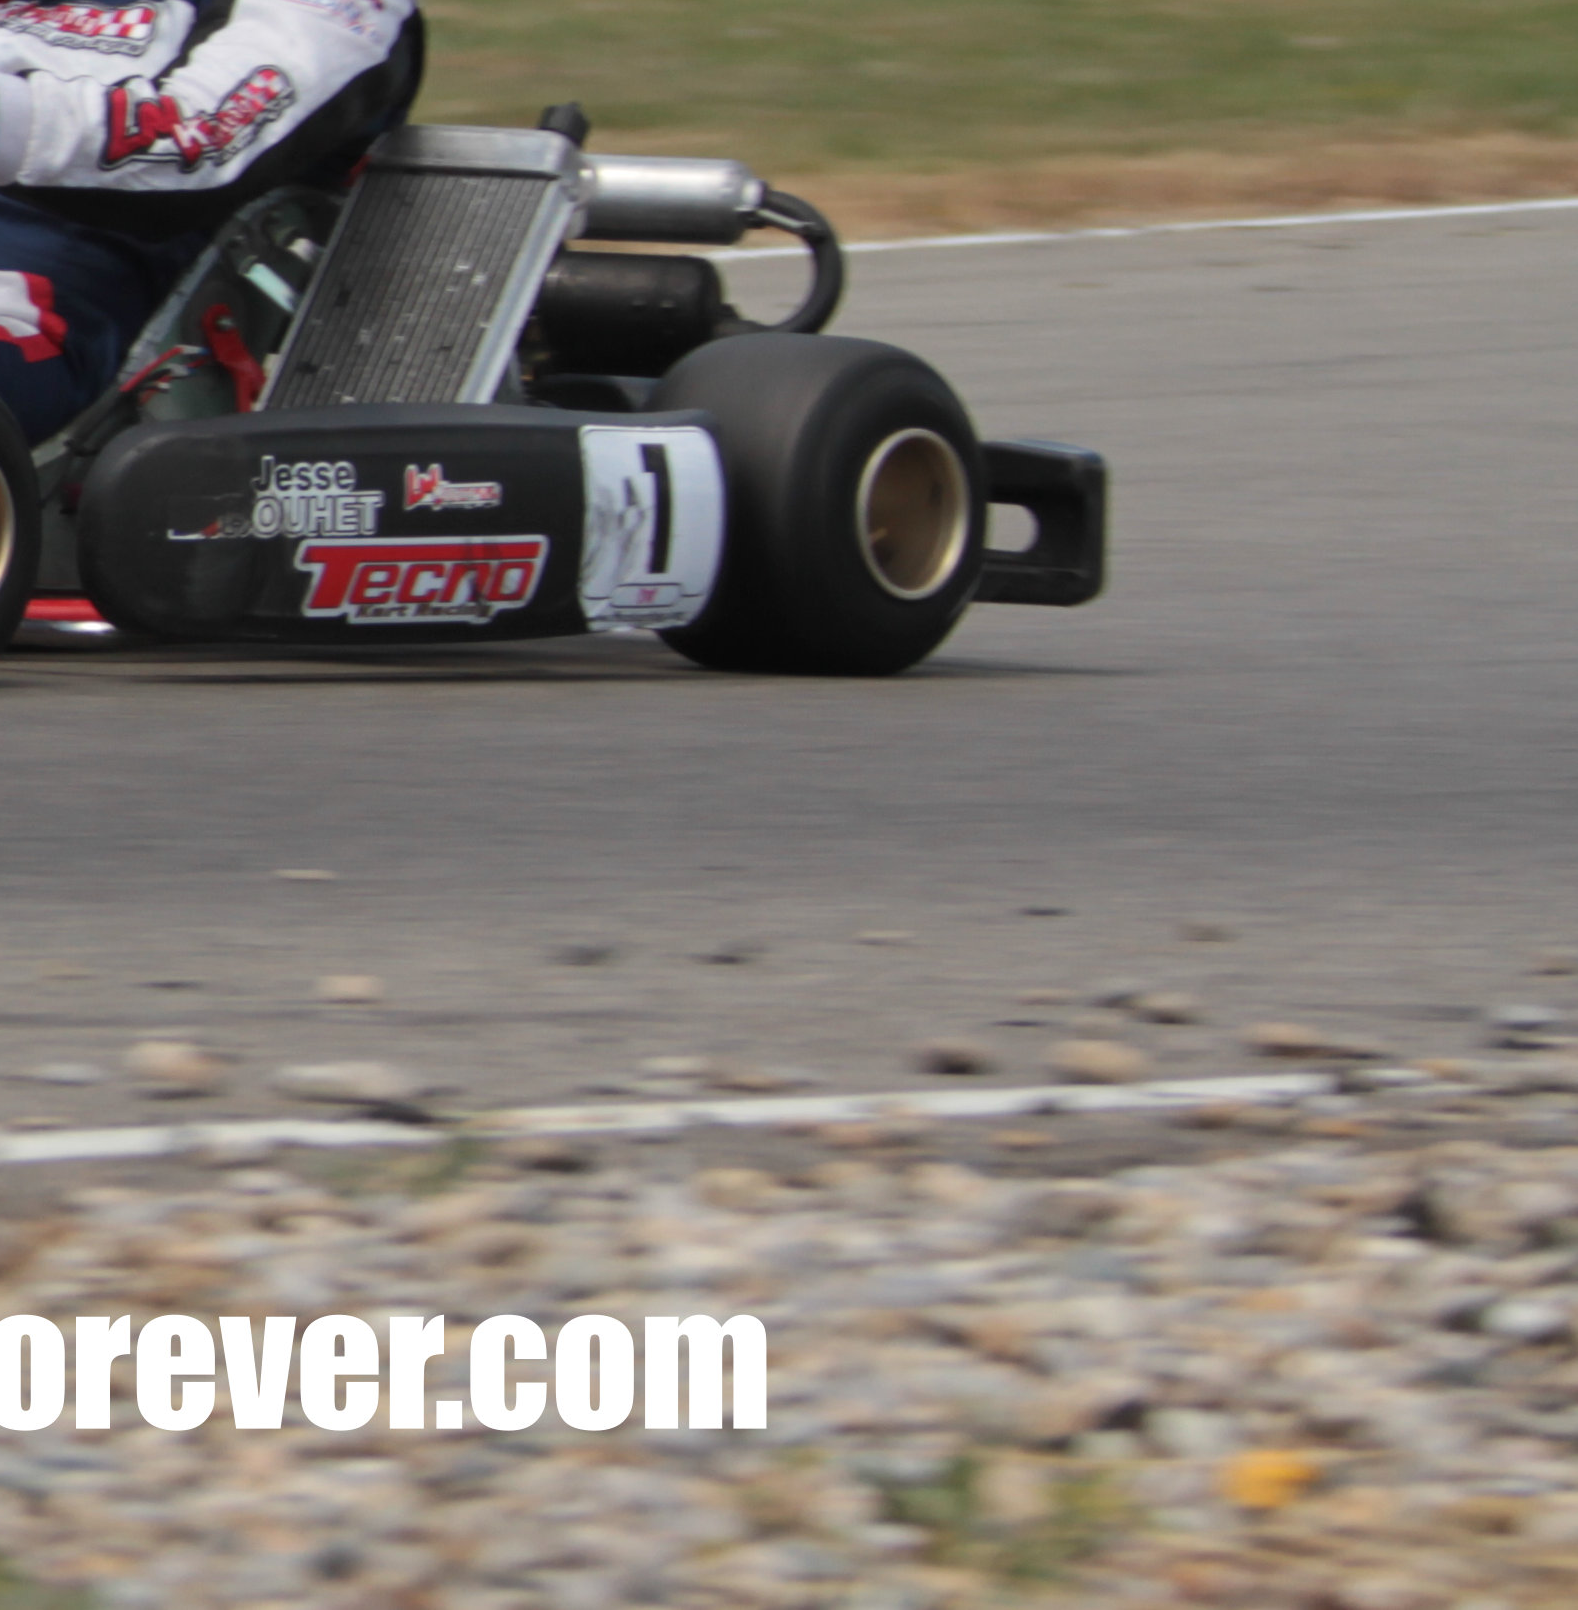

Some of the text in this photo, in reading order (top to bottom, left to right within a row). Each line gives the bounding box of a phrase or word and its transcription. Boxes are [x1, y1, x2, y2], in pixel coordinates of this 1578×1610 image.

[251, 455, 356, 491] Jesse
[639, 443, 673, 575] 1
[300, 541, 545, 610] Tecno
